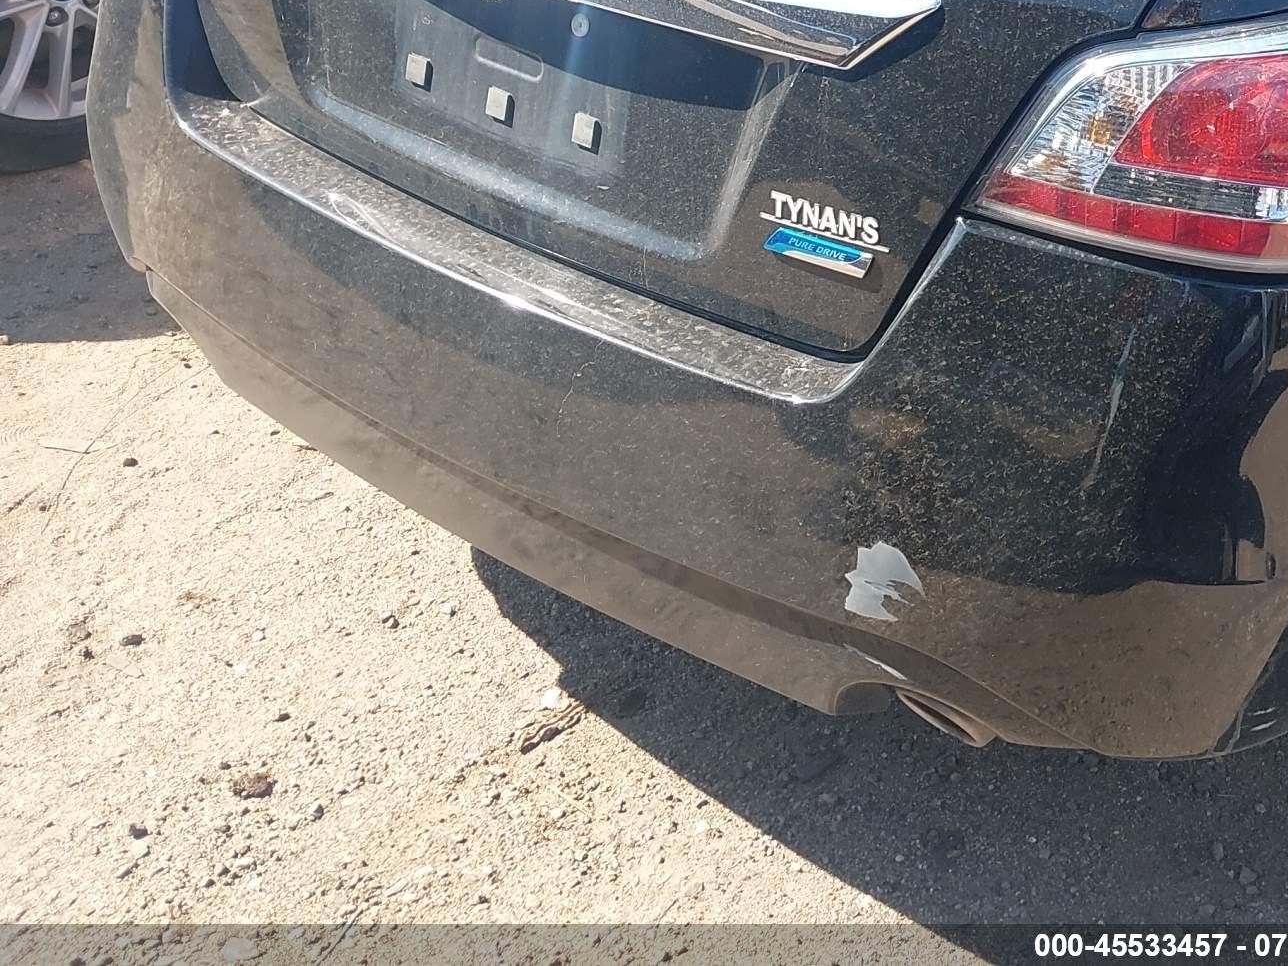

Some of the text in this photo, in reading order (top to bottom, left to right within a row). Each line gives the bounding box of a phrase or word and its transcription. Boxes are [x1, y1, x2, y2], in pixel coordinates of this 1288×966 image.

[770, 189, 879, 245] TYNAN'S
[788, 236, 848, 262] PURE DRIVE
